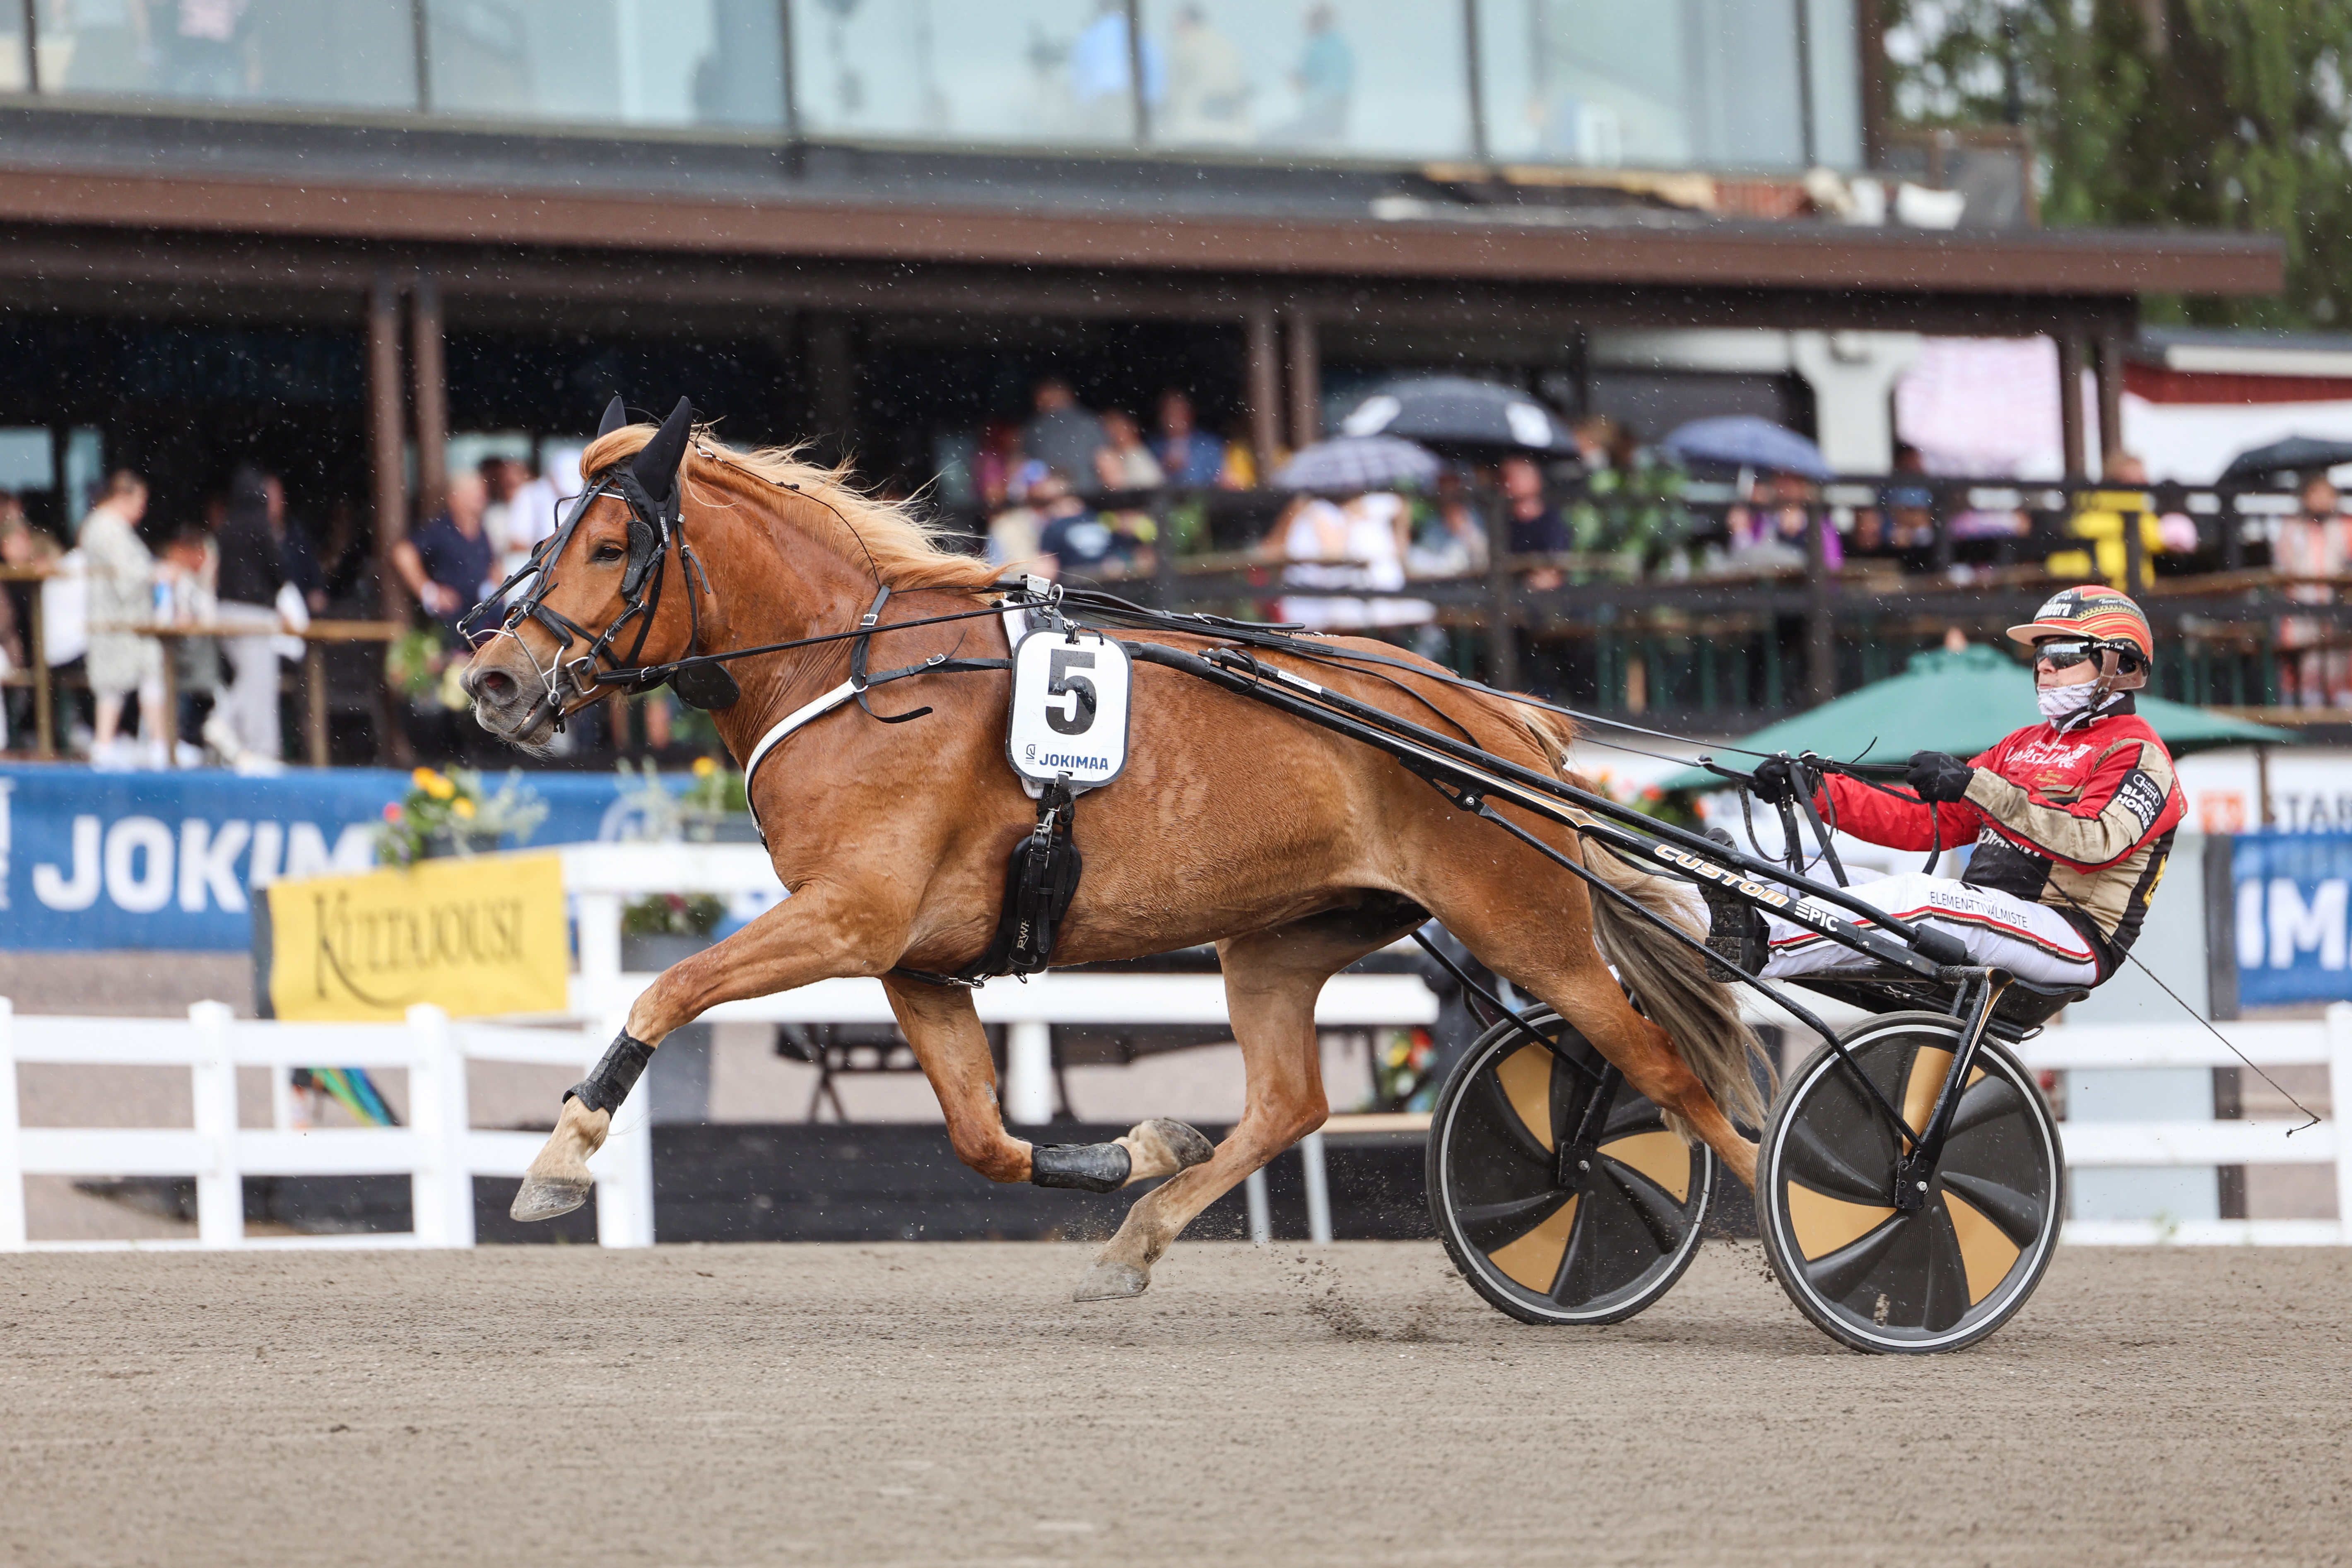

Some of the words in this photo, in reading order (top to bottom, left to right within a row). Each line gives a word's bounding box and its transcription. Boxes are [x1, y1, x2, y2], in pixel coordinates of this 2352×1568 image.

[1045, 648, 1097, 735] 5
[1280, 673, 1309, 686] CUSTOM
[1039, 754, 1109, 770] JOKIMAA
[2116, 794, 2150, 830] HORSE
[2121, 783, 2156, 821] BLACK
[32, 815, 383, 913] JOKIM
[1654, 844, 1790, 908] CUSTOM
[1794, 900, 1840, 932] EPIC
